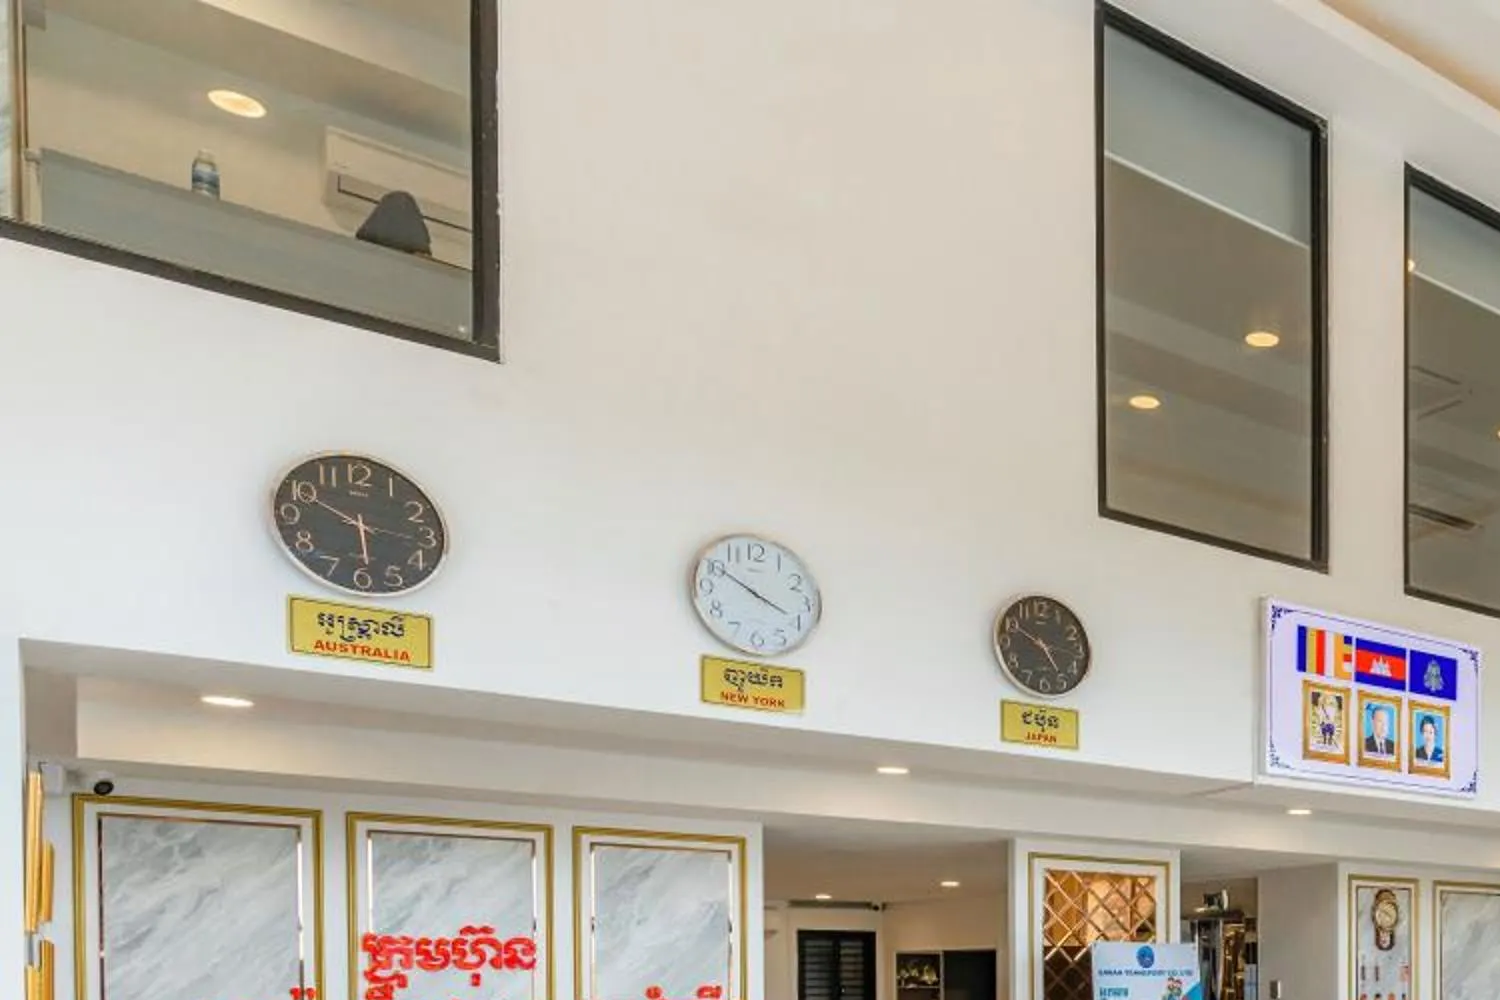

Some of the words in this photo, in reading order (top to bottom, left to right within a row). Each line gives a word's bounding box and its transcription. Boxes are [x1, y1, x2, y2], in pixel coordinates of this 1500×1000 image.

[320, 463, 338, 488] 11
[348, 463, 372, 487] 12
[291, 480, 317, 504] 10
[387, 476, 394, 498] 1
[405, 501, 425, 523] 2
[295, 531, 314, 553] 8
[417, 527, 437, 549] 3
[319, 556, 340, 577] 7
[407, 549, 426, 571] 4
[353, 567, 373, 589] 6
[384, 565, 403, 587] 5
[313, 639, 411, 662] AUSTRALIA
[721, 690, 749, 704] NEW
[752, 695, 786, 708] YORK
[1026, 731, 1057, 743] JAPAN
